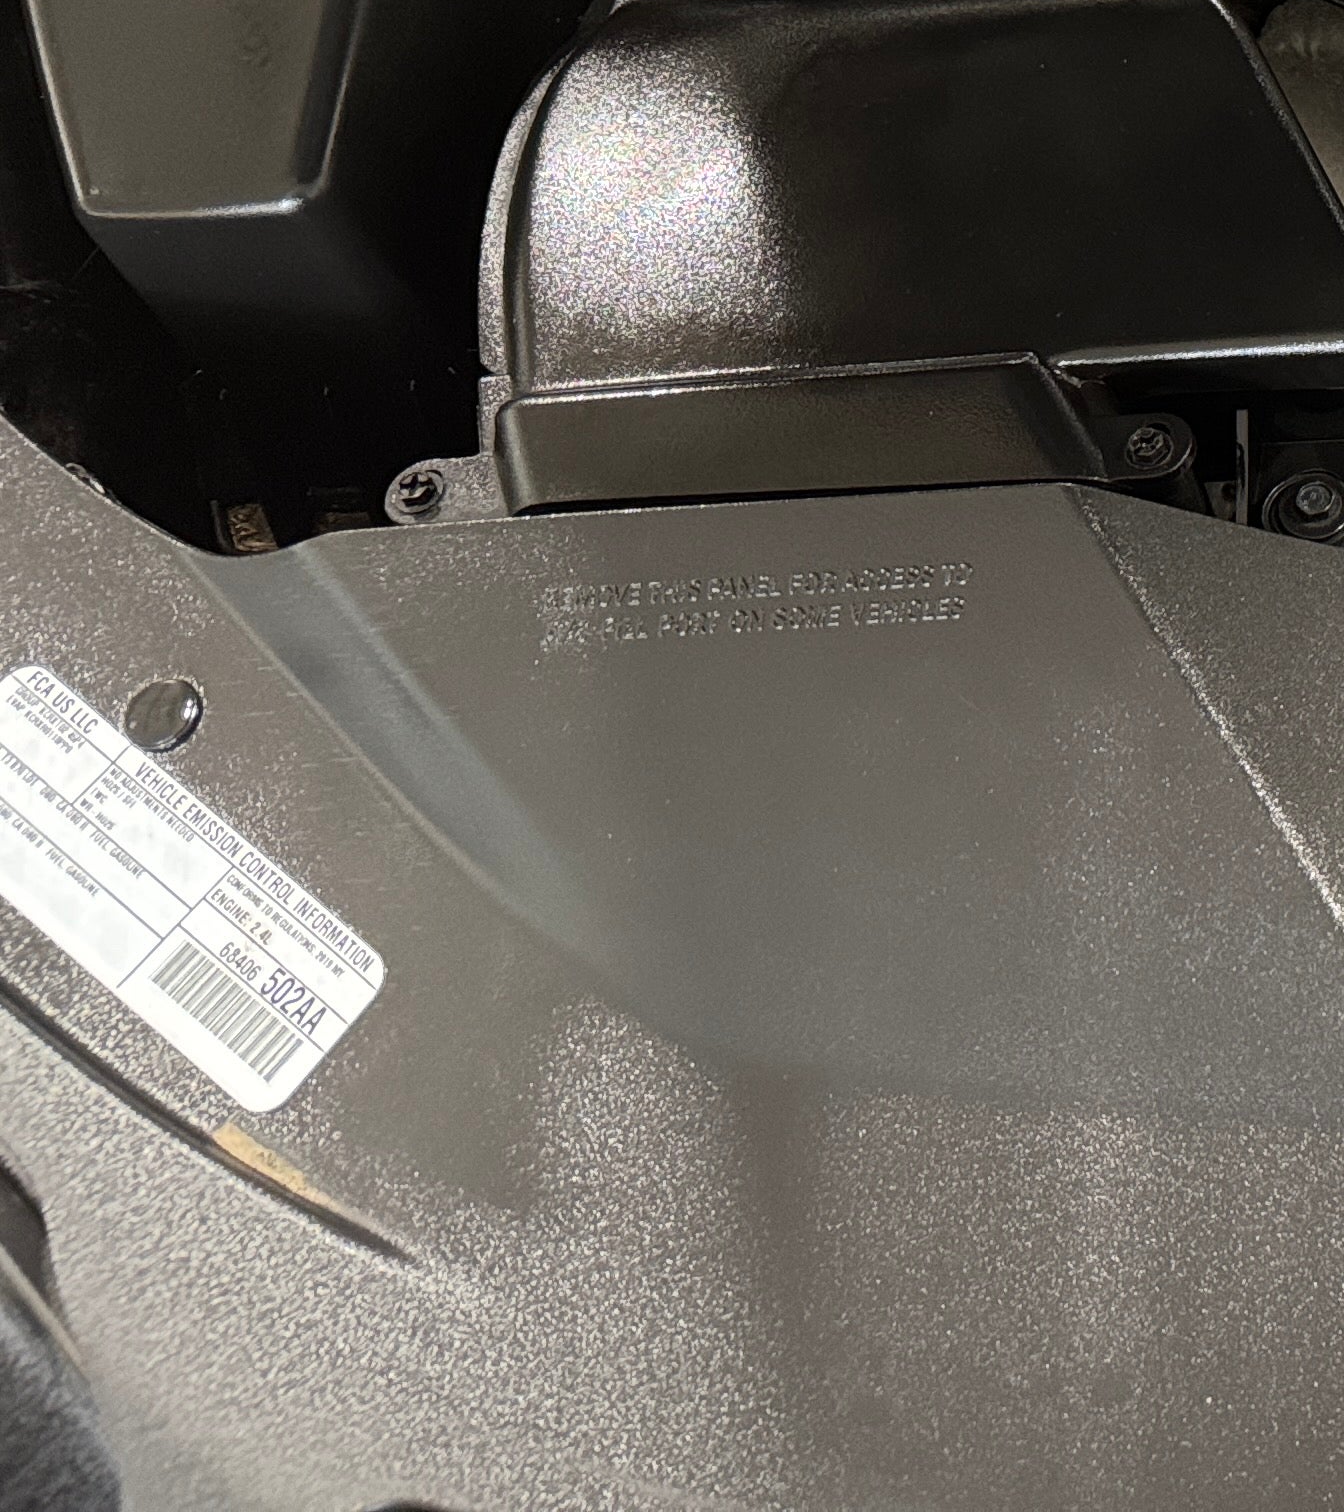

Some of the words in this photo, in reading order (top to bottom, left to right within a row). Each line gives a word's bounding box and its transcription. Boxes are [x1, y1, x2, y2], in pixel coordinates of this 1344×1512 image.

[25, 669, 58, 699] FCA
[50, 690, 76, 715] US
[68, 706, 100, 735] LLC
[132, 760, 188, 811] VEHICLE
[181, 802, 244, 859] EMISSION
[237, 850, 299, 905] CONTROL
[291, 897, 376, 972] INFORMATION
[209, 887, 254, 927] ENGINE:
[247, 920, 276, 946] 2.4L
[216, 940, 263, 982] 68406
[256, 966, 333, 1036] 502AA
